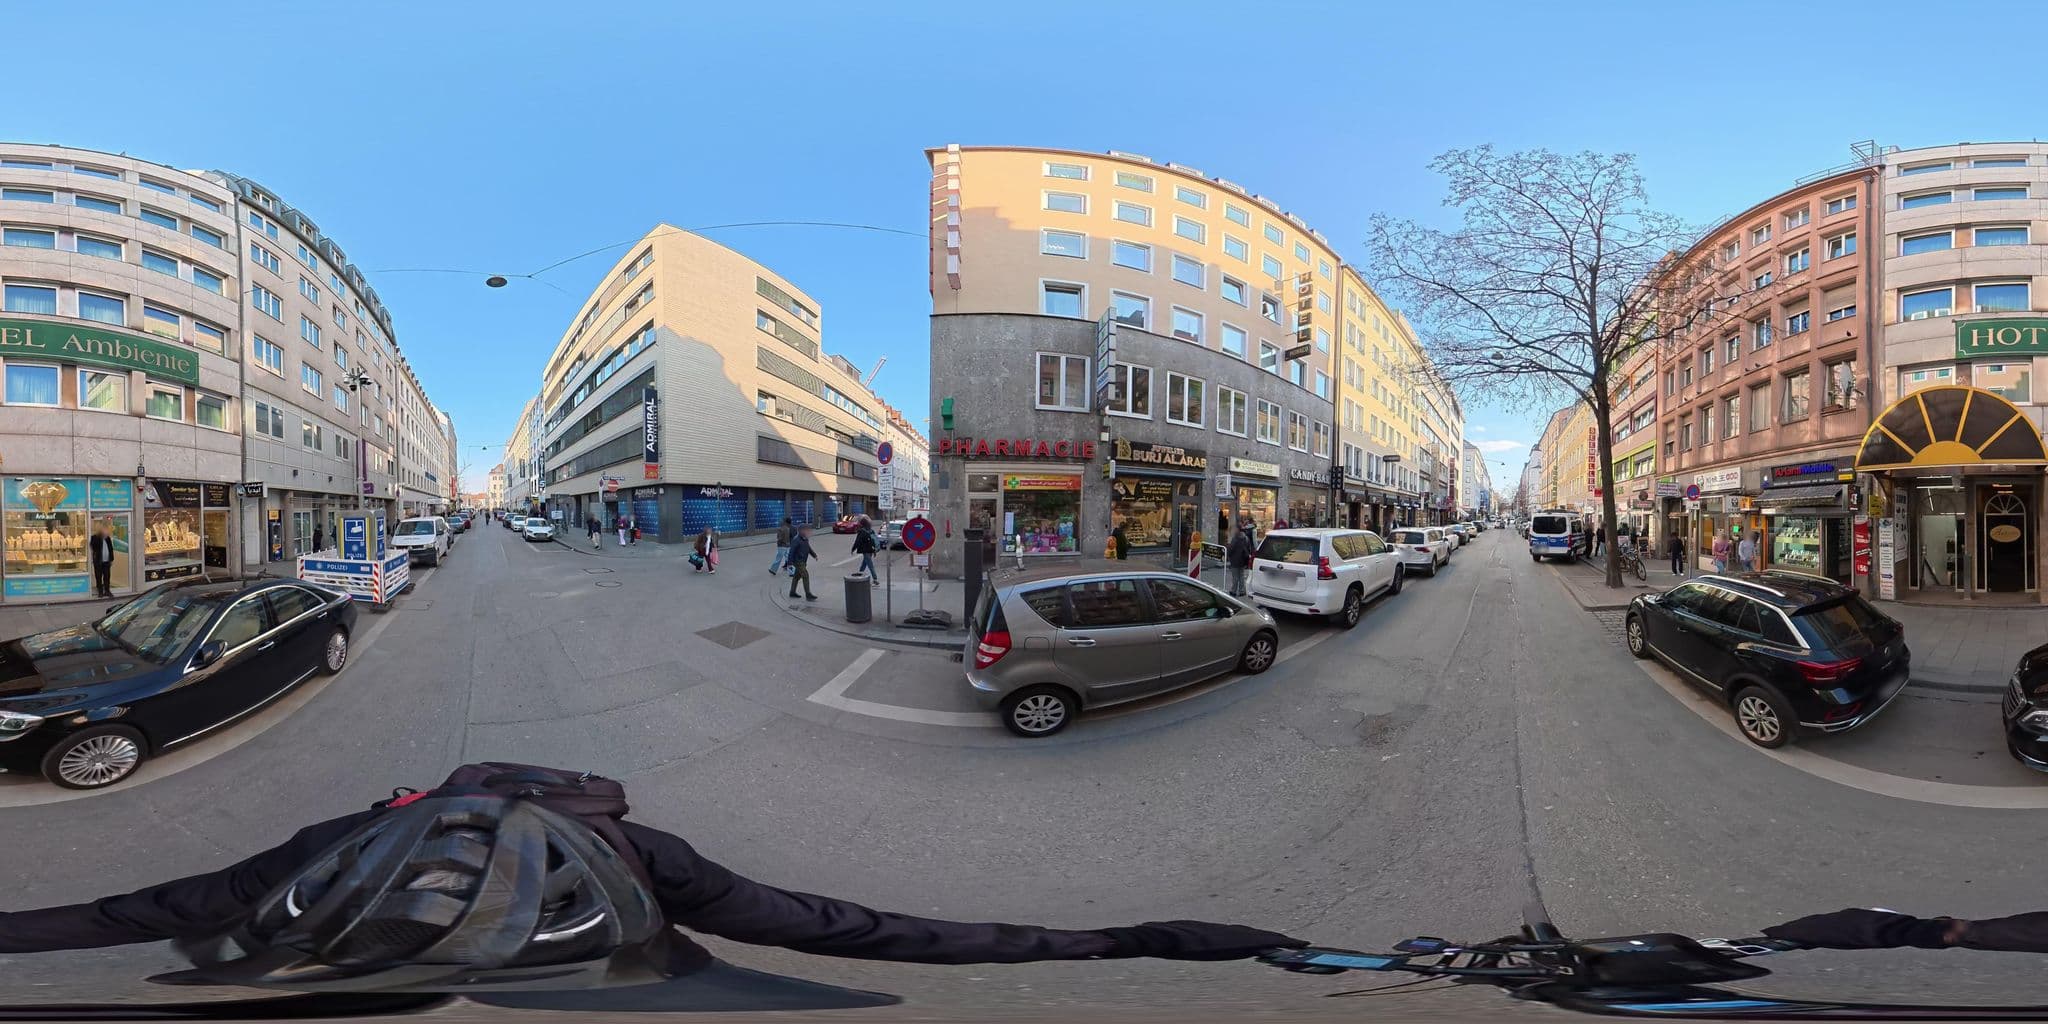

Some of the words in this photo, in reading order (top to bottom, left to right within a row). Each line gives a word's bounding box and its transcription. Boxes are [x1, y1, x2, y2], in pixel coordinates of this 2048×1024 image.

[1299, 271, 1311, 340] HOTEL
[1971, 327, 2047, 347] HOT
[0, 327, 46, 348] EL
[62, 334, 190, 374] Ambiente
[645, 398, 655, 453] ADMIRAL
[939, 438, 1097, 458] PHARMACIE
[1133, 450, 1161, 462] BURJ
[1151, 444, 1185, 455] JUWELIER
[1291, 468, 1315, 482] CANDY
[635, 487, 656, 496] ADMIRAL
